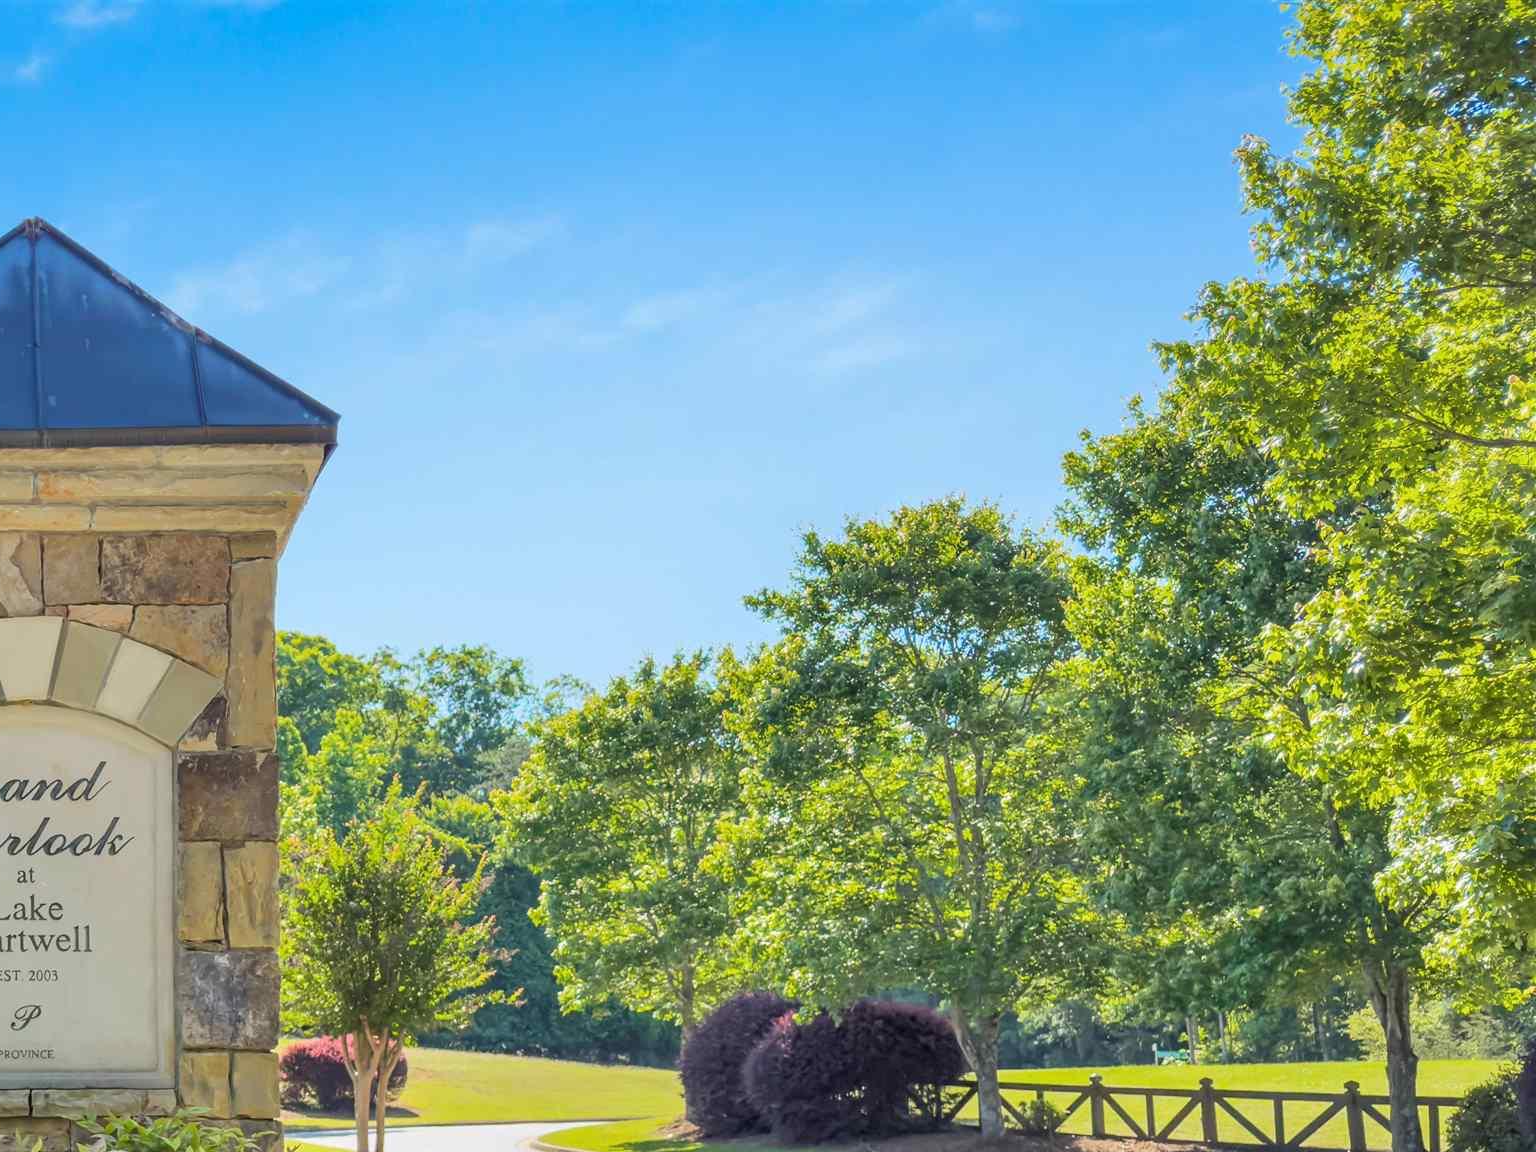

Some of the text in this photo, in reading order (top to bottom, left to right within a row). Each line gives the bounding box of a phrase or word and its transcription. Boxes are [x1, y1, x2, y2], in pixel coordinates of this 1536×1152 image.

[16, 867, 36, 884] at
[28, 969, 59, 982] 2003
[10, 1004, 42, 1031] P
